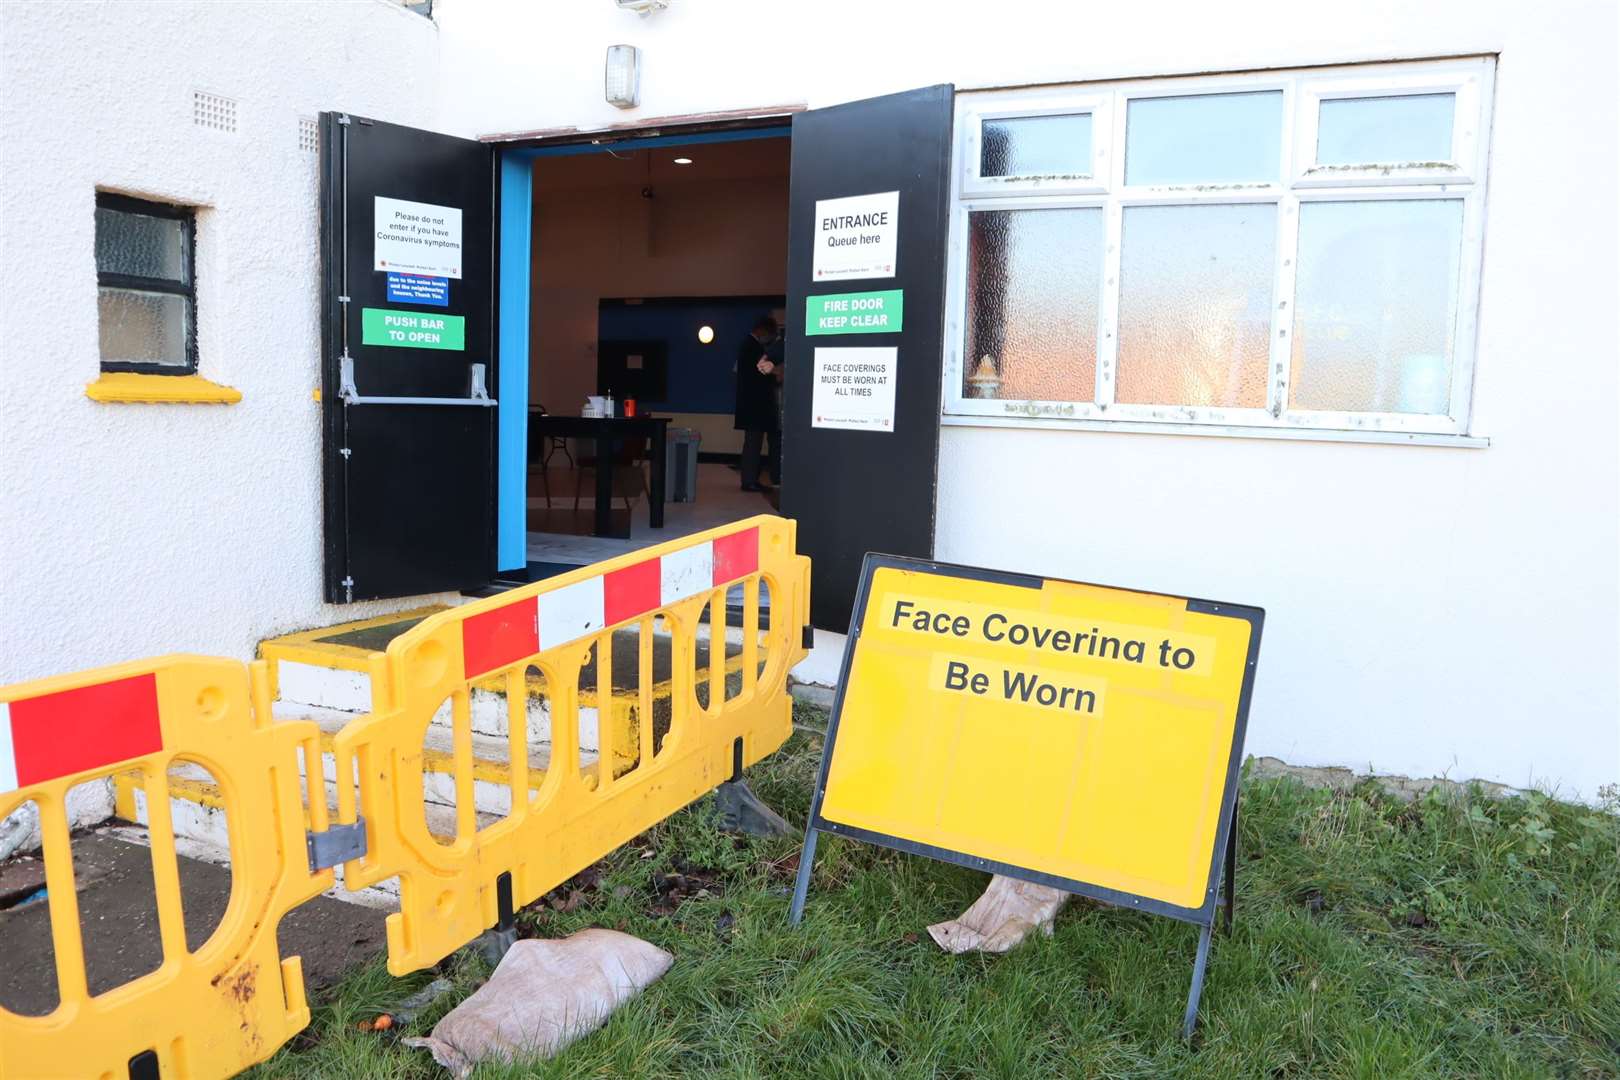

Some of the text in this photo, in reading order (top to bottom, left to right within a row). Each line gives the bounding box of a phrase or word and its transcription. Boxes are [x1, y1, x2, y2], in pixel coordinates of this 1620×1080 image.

[395, 211, 419, 222] Please
[823, 212, 888, 231] ENTRANCE
[433, 228, 449, 236] have
[377, 232, 460, 248] Coronavirus symptoms
[828, 234, 881, 247] Queue here
[824, 298, 883, 312] FIRE DOOR
[385, 316, 444, 330] PUSH BAR
[820, 314, 888, 328] KEEP CLEAR
[389, 330, 440, 344] TO OPEN
[843, 364, 886, 372] COVERINGS
[850, 388, 872, 396] TIMES
[892, 600, 970, 636] Face
[1159, 639, 1195, 670] to
[945, 661, 1096, 712] Be Worn
